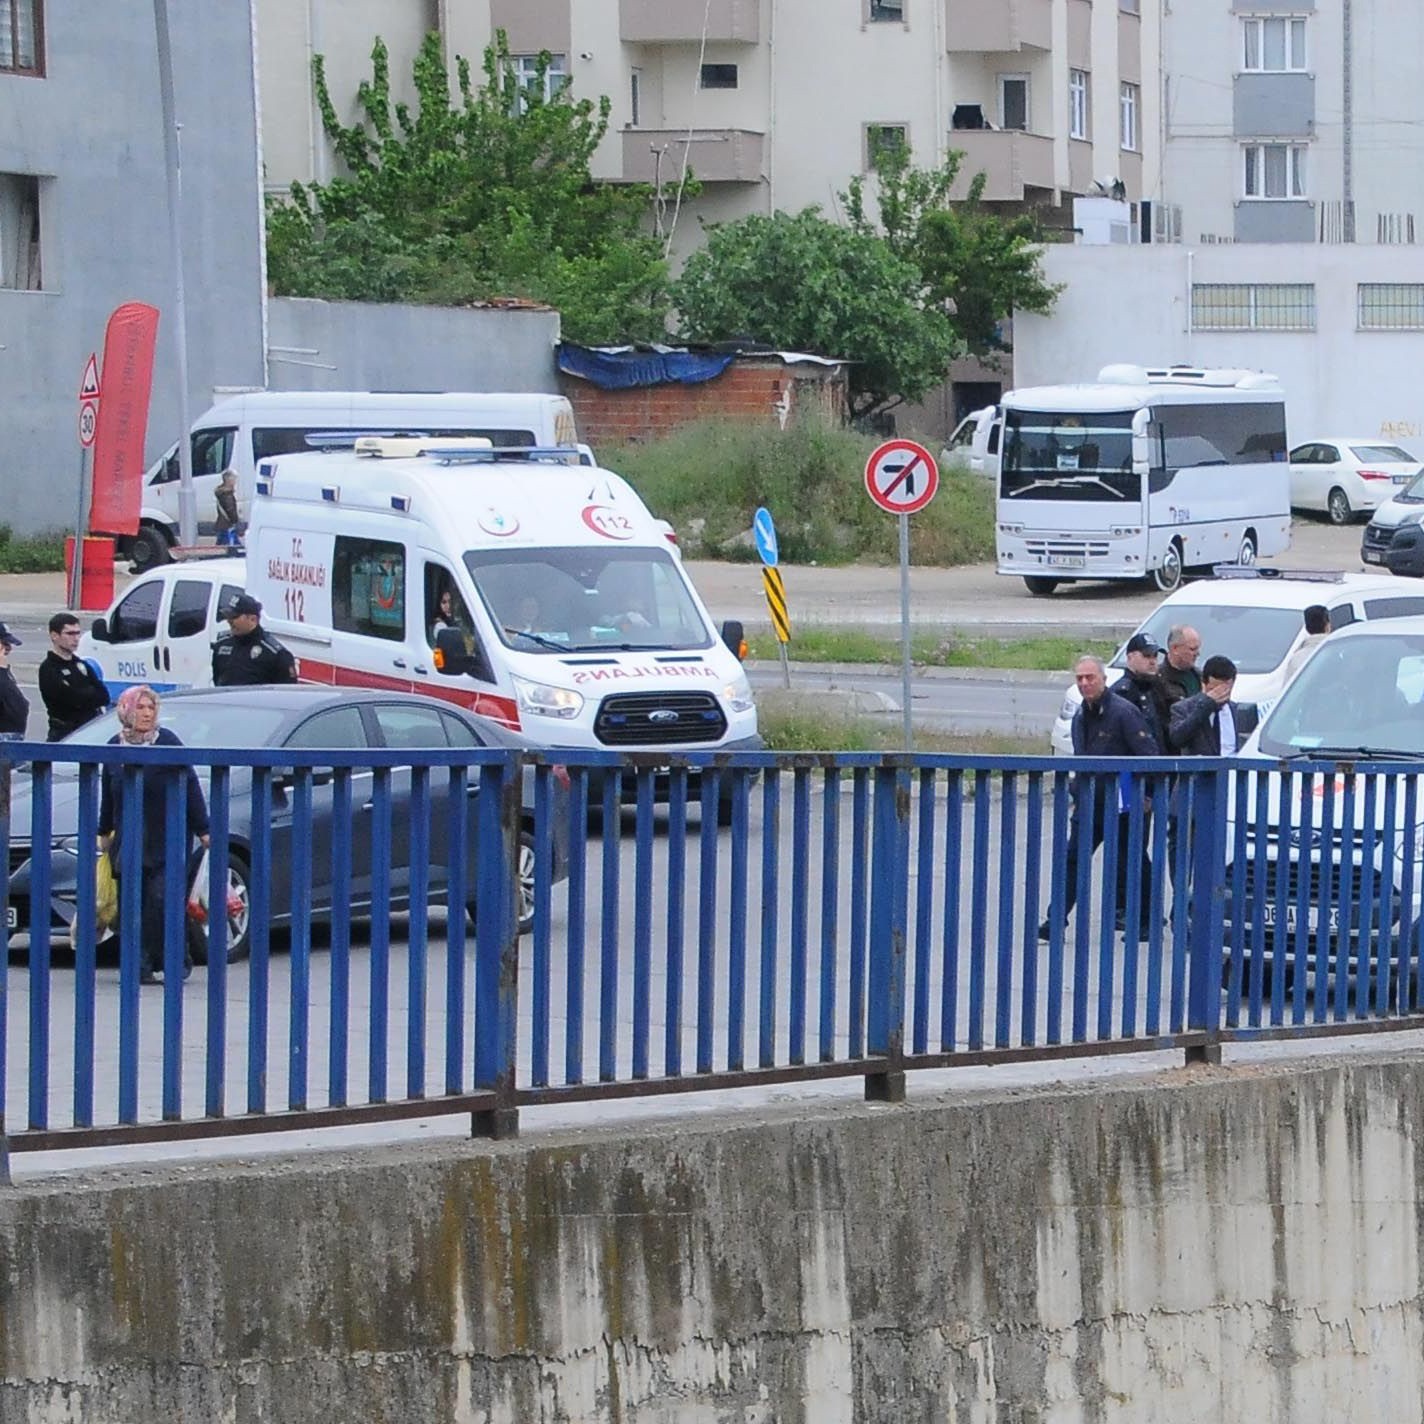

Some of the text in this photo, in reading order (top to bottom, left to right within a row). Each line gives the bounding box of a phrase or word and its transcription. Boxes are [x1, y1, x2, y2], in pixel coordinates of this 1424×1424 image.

[82, 414, 94, 434] 30
[596, 515, 633, 529] 112
[268, 556, 290, 582] SAĞLIK
[284, 587, 305, 622] 112
